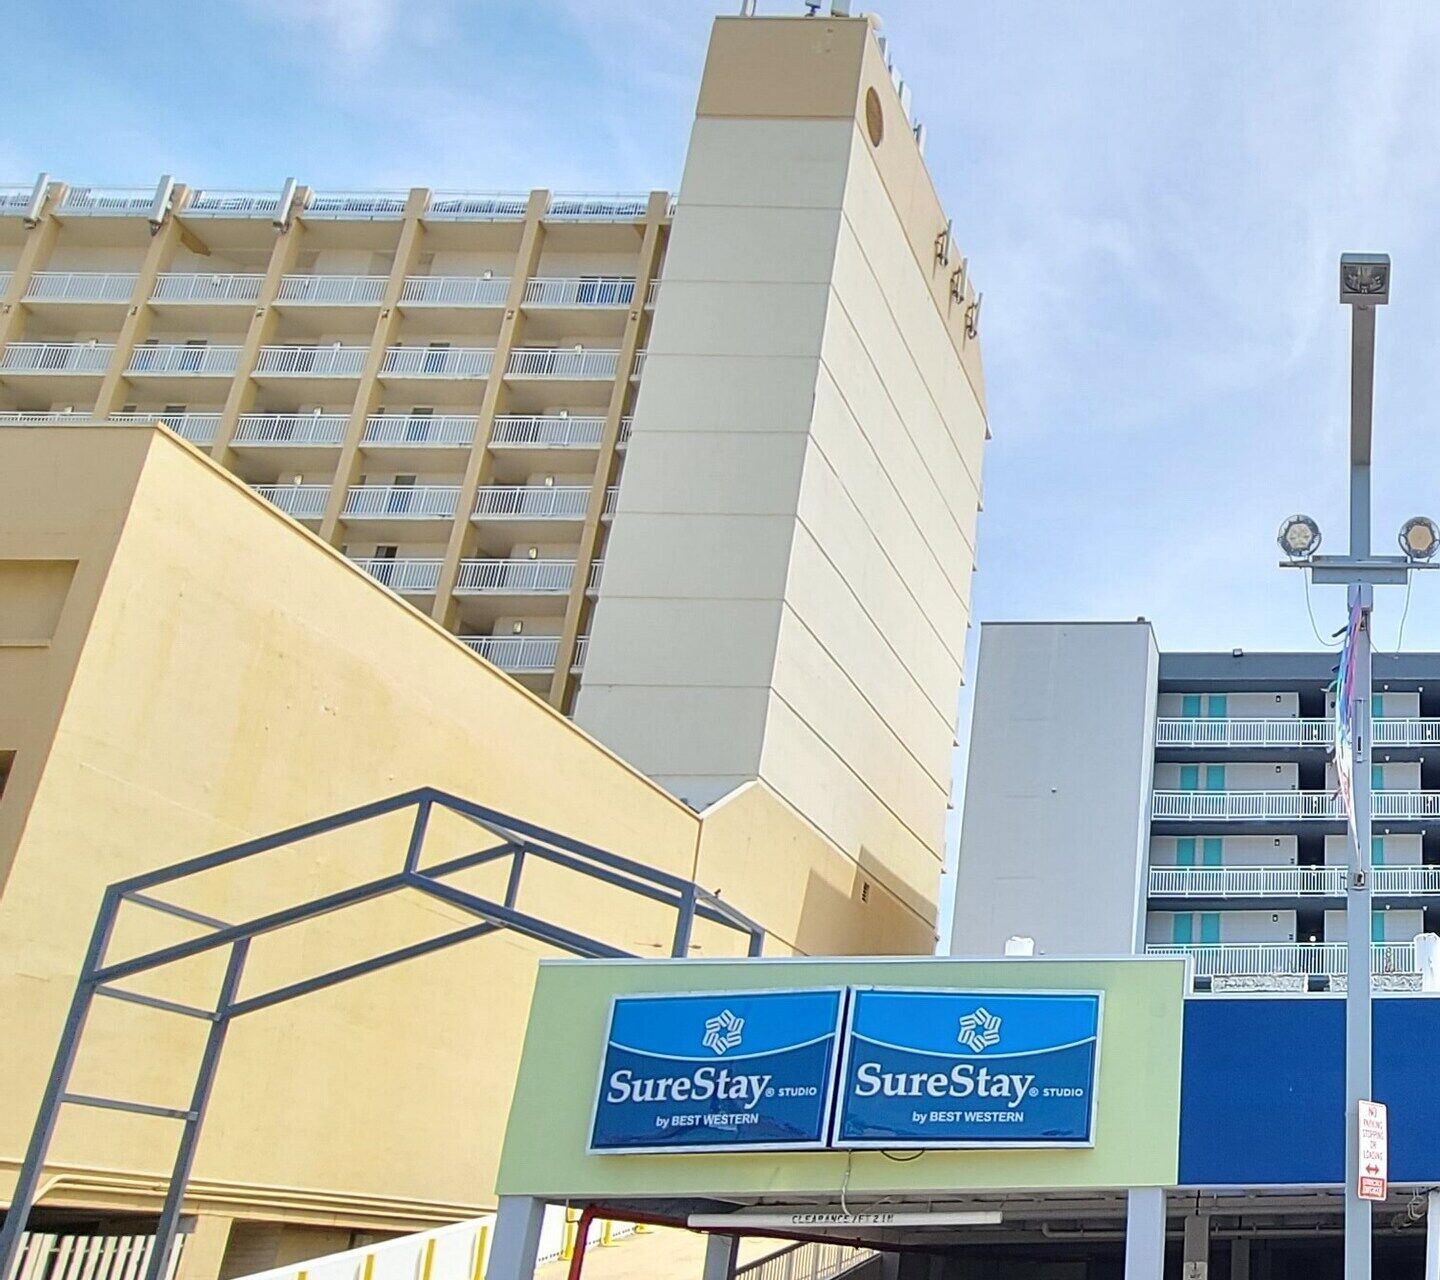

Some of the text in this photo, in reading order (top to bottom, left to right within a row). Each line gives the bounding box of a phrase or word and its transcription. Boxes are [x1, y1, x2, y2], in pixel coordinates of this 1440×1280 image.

[778, 1086, 818, 1097] STUDIO
[1043, 1088, 1084, 1097] STUDIO
[655, 1113, 759, 1129] by BEST WESTERN
[912, 1111, 1024, 1125] by BEST WESTERN
